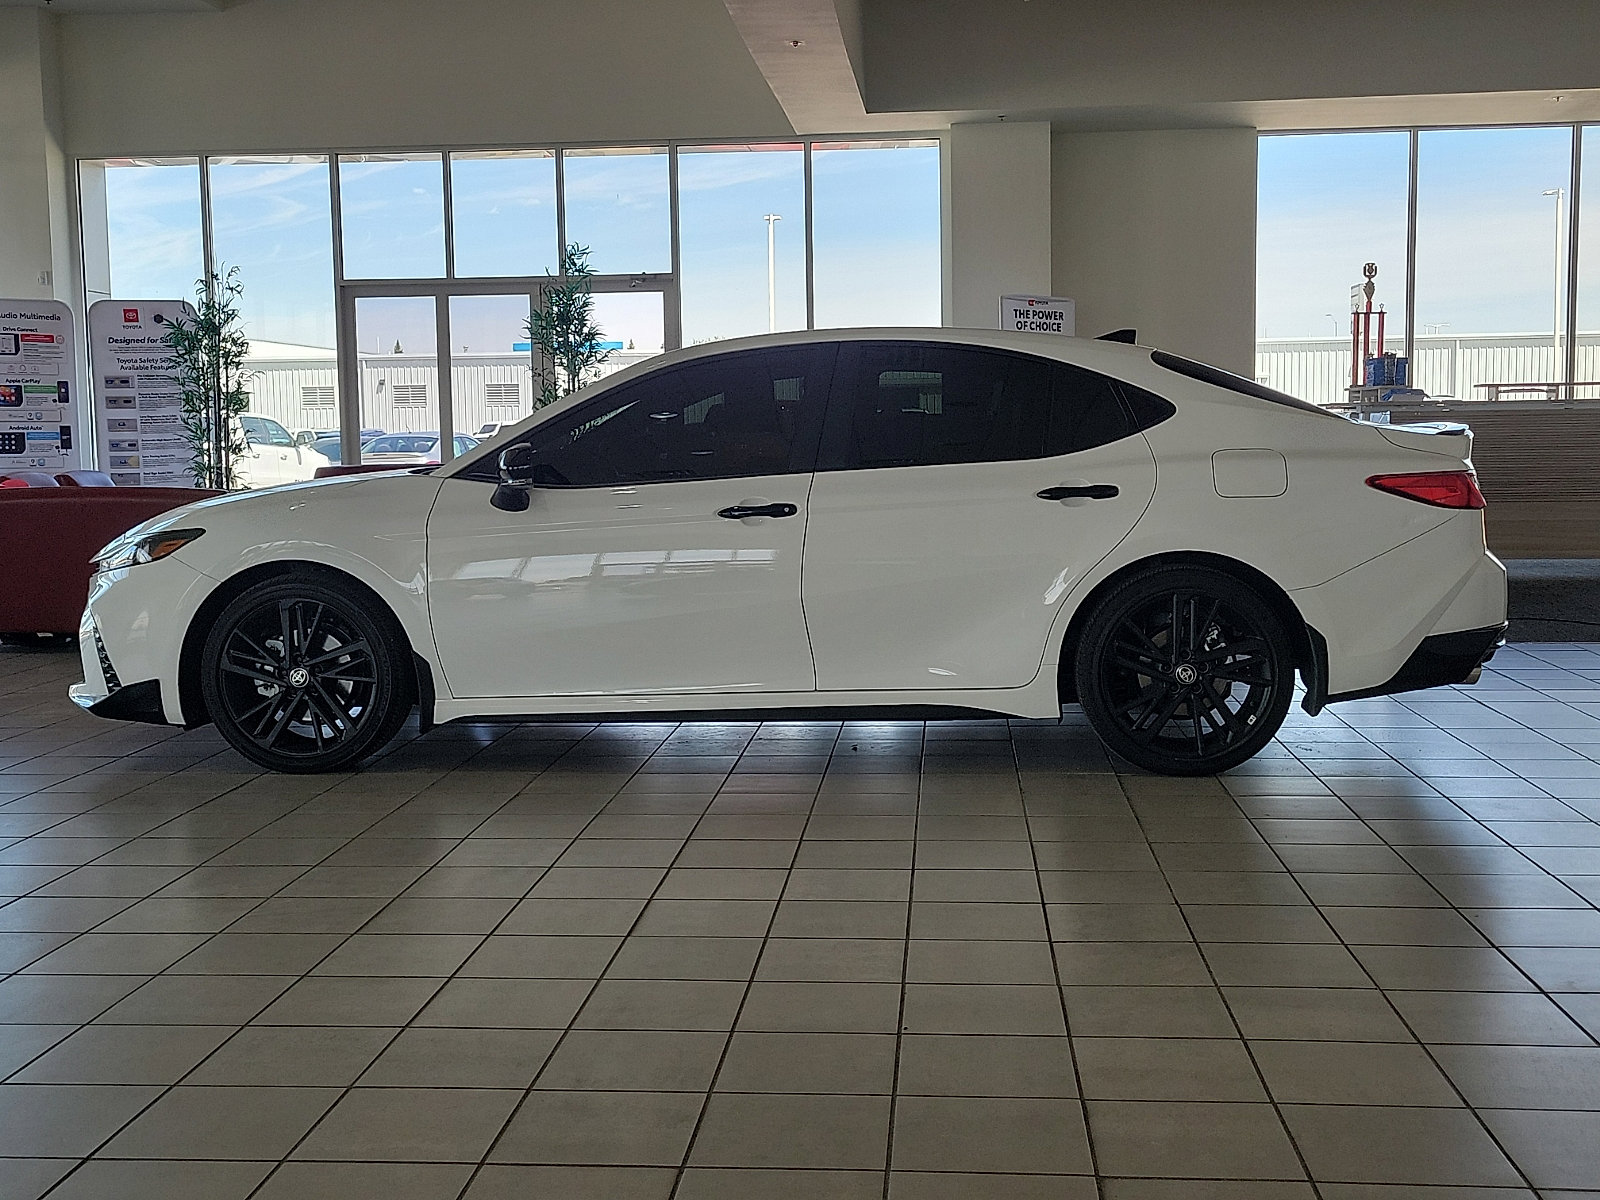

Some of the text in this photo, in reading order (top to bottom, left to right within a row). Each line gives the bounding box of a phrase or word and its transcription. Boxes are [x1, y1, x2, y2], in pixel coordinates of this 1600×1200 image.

[0, 312, 61, 321] udio Multimedia
[1013, 309, 1064, 321] THE POWER
[1016, 321, 1062, 332] OF CHOICE
[108, 336, 146, 345] Designed
